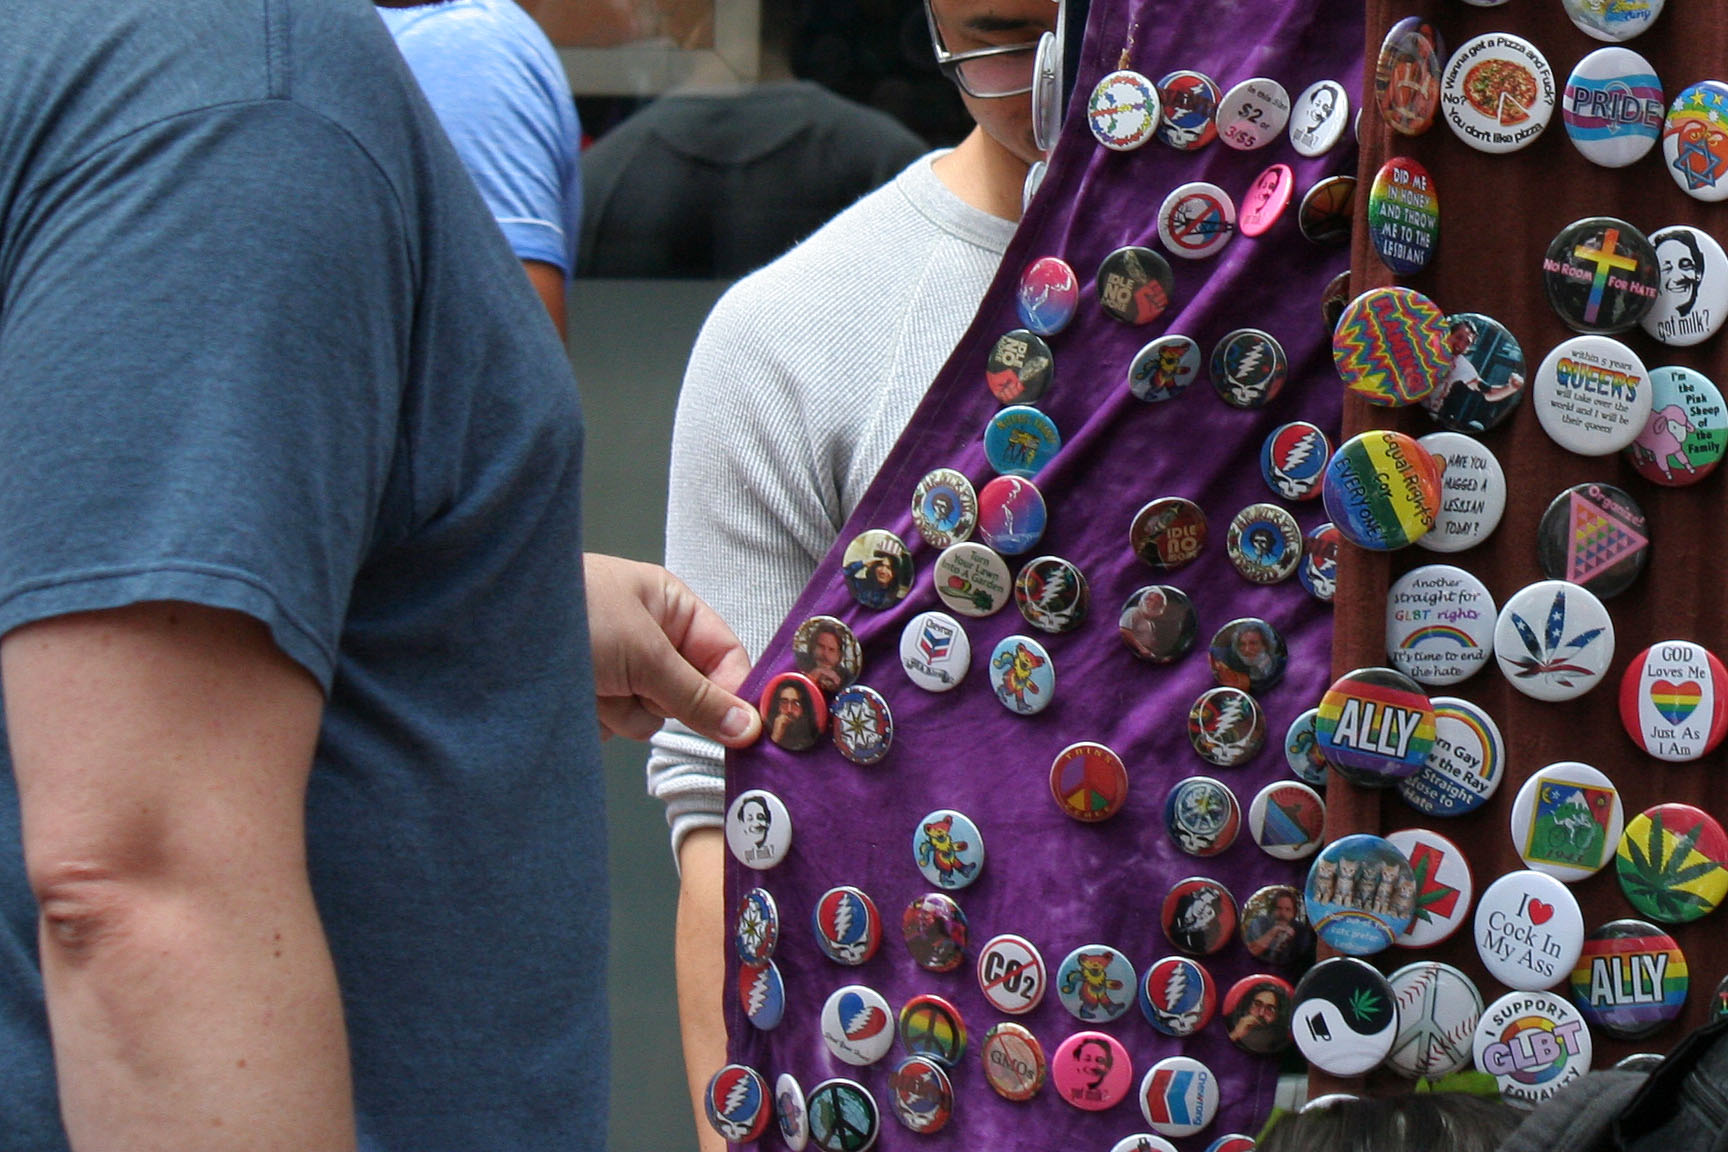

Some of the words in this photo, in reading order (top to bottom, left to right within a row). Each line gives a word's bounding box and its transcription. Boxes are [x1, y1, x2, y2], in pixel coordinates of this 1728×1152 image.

[1445, 53, 1468, 91] Wanna
[1469, 42, 1486, 58] get
[1496, 38, 1526, 54] Pizza
[1525, 49, 1546, 71] and
[1238, 102, 1260, 122] $2
[1572, 87, 1662, 127] PRIDE
[1448, 108, 1467, 129] You
[1466, 122, 1492, 143] don't
[1492, 131, 1514, 144] like
[1514, 122, 1544, 144] pizza
[1412, 174, 1428, 191] ME
[1379, 204, 1401, 221] AND
[1404, 209, 1436, 230] THROW
[1382, 222, 1398, 238] ME
[1400, 227, 1413, 243] TO
[1415, 229, 1431, 248] THE
[1383, 241, 1425, 265] LESBIANS
[1105, 286, 1132, 302] NO
[1657, 319, 1676, 342] got
[1678, 310, 1711, 337] milk?
[1571, 349, 1599, 363] within
[1609, 359, 1632, 372] years
[1556, 357, 1641, 403] QUEERS
[1679, 382, 1694, 393] the
[1556, 388, 1572, 399] will
[1690, 404, 1720, 417] Sheep
[1688, 441, 1720, 454] Family
[1470, 456, 1487, 470] YOU
[1382, 433, 1411, 481] Equal
[1406, 472, 1434, 526] Rights
[1443, 499, 1485, 514] LESBIAN
[1589, 485, 1646, 527] Organize!
[1167, 526, 1197, 538] IDLE
[972, 571, 1004, 593] Garden
[975, 563, 1000, 580] Lawn
[1412, 577, 1461, 588] Another
[1394, 589, 1455, 606] straight
[1458, 590, 1481, 606] for
[1395, 609, 1432, 622] GLBT
[1437, 607, 1481, 623] rights
[1414, 652, 1443, 662] time
[1460, 650, 1485, 661] end
[1661, 647, 1693, 662] GOD
[1648, 665, 1684, 678] Loves
[1689, 666, 1706, 679] Me
[1332, 698, 1423, 760] ALLY
[1650, 726, 1676, 739] Just
[1681, 727, 1700, 740] As
[1064, 748, 1113, 764] THINK
[1453, 745, 1480, 768] Gay
[1667, 742, 1691, 755] Am
[1422, 768, 1475, 805] Straight
[1437, 759, 1460, 778] the
[1463, 773, 1489, 794] Ray
[1404, 787, 1433, 811] Hate
[1439, 794, 1453, 808] to
[1516, 894, 1529, 917] I
[1489, 912, 1539, 948] Cock
[1543, 934, 1562, 959] In
[1483, 930, 1515, 962] My
[1517, 952, 1554, 977] Ass
[1591, 953, 1668, 1006] ALLY
[1493, 1000, 1568, 1026] SUPPORT
[1483, 1019, 1583, 1076] GLBT
[990, 1048, 1035, 1079] GMOs
